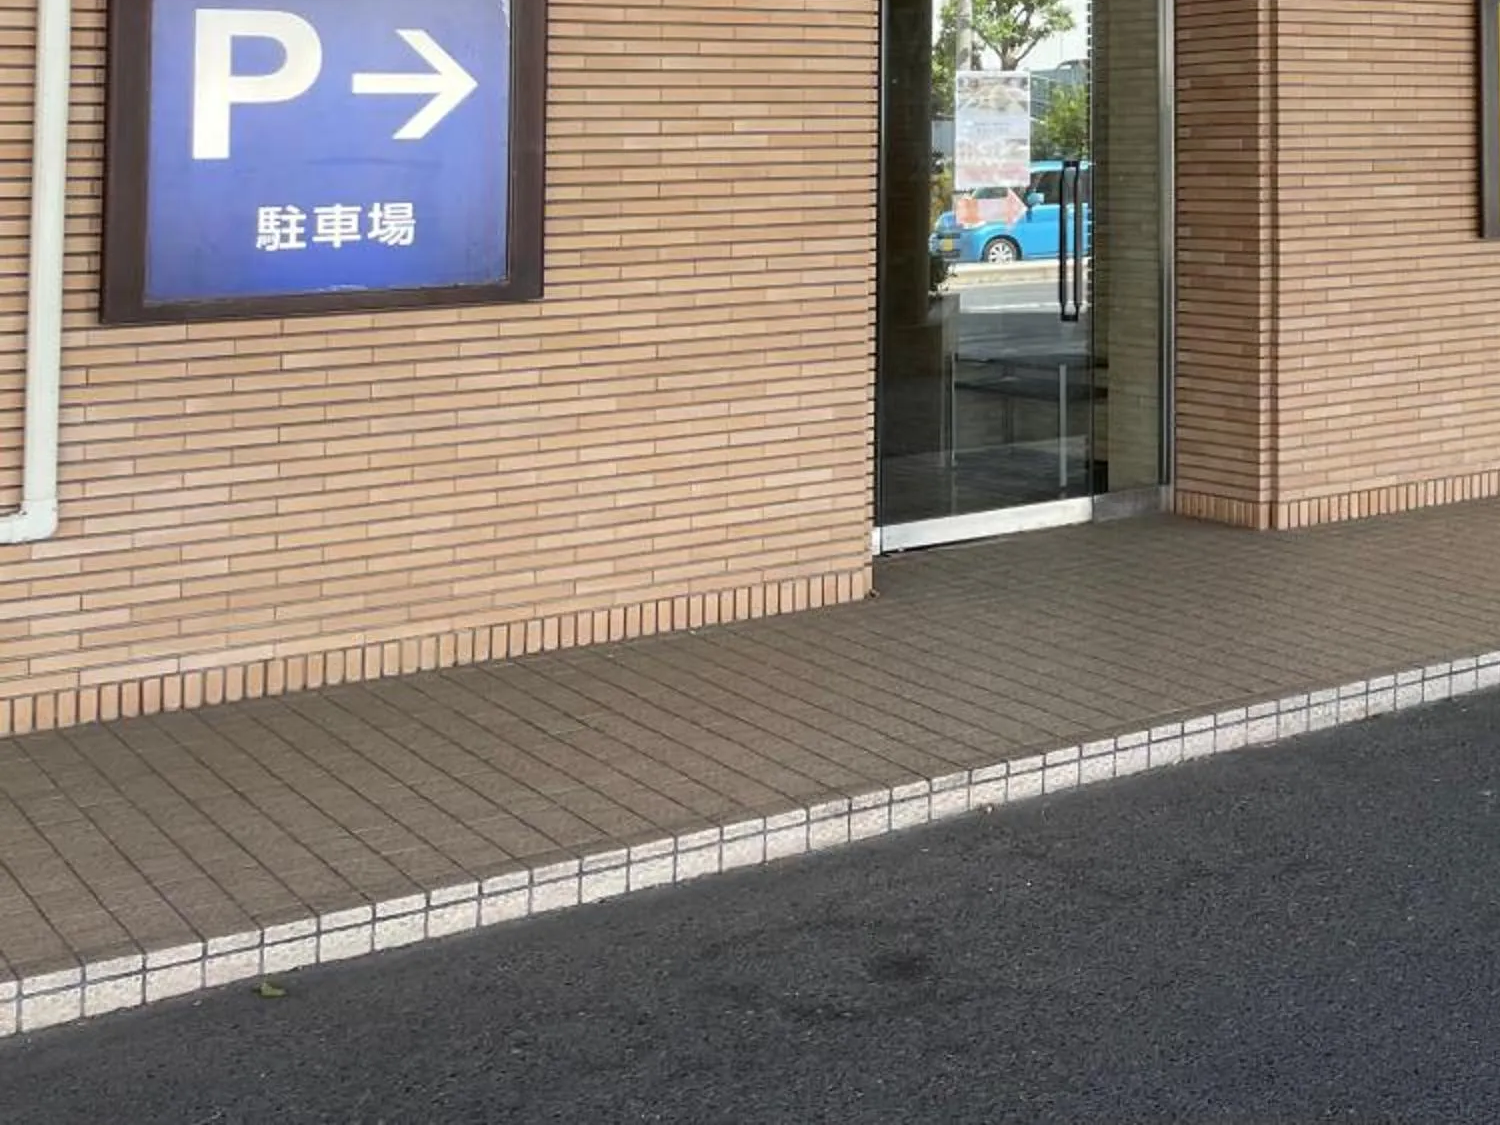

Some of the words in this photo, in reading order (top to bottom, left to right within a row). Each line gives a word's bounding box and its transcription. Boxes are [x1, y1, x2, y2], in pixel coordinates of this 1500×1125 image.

[191, 8, 323, 160] P
[255, 203, 417, 252] 駐車場
